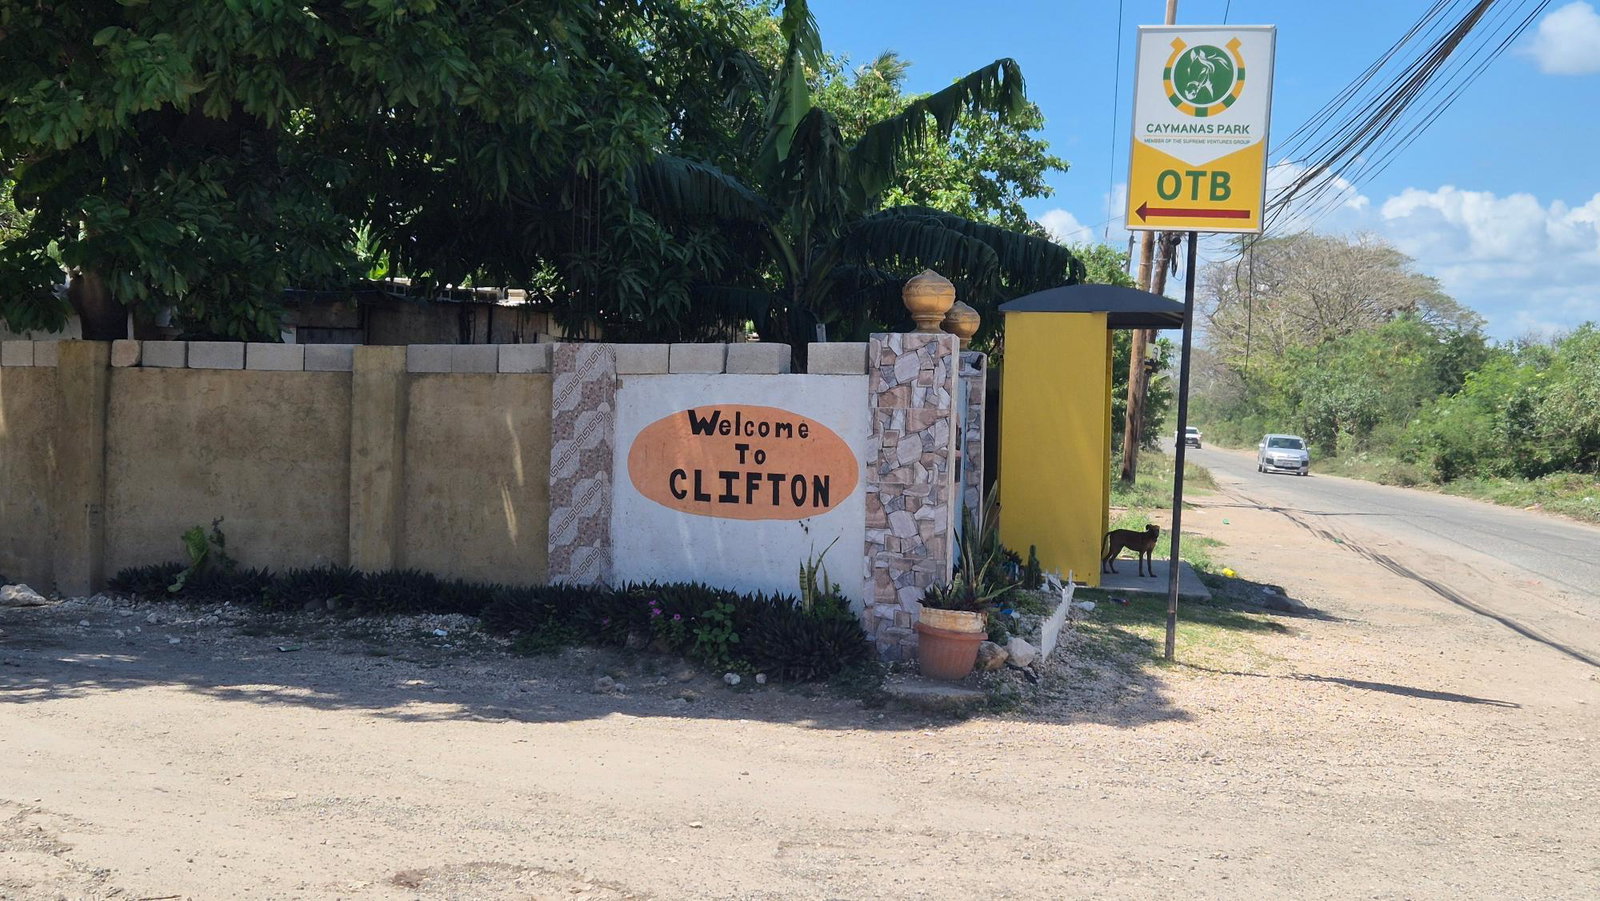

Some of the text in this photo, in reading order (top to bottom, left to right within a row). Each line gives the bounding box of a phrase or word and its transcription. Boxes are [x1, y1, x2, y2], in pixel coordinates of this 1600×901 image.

[1146, 123, 1250, 134] CAYMANAS PARK
[1156, 169, 1232, 202] OTB
[688, 409, 809, 439] Welcome
[735, 443, 766, 465] To
[669, 468, 830, 508] CLIFTON
